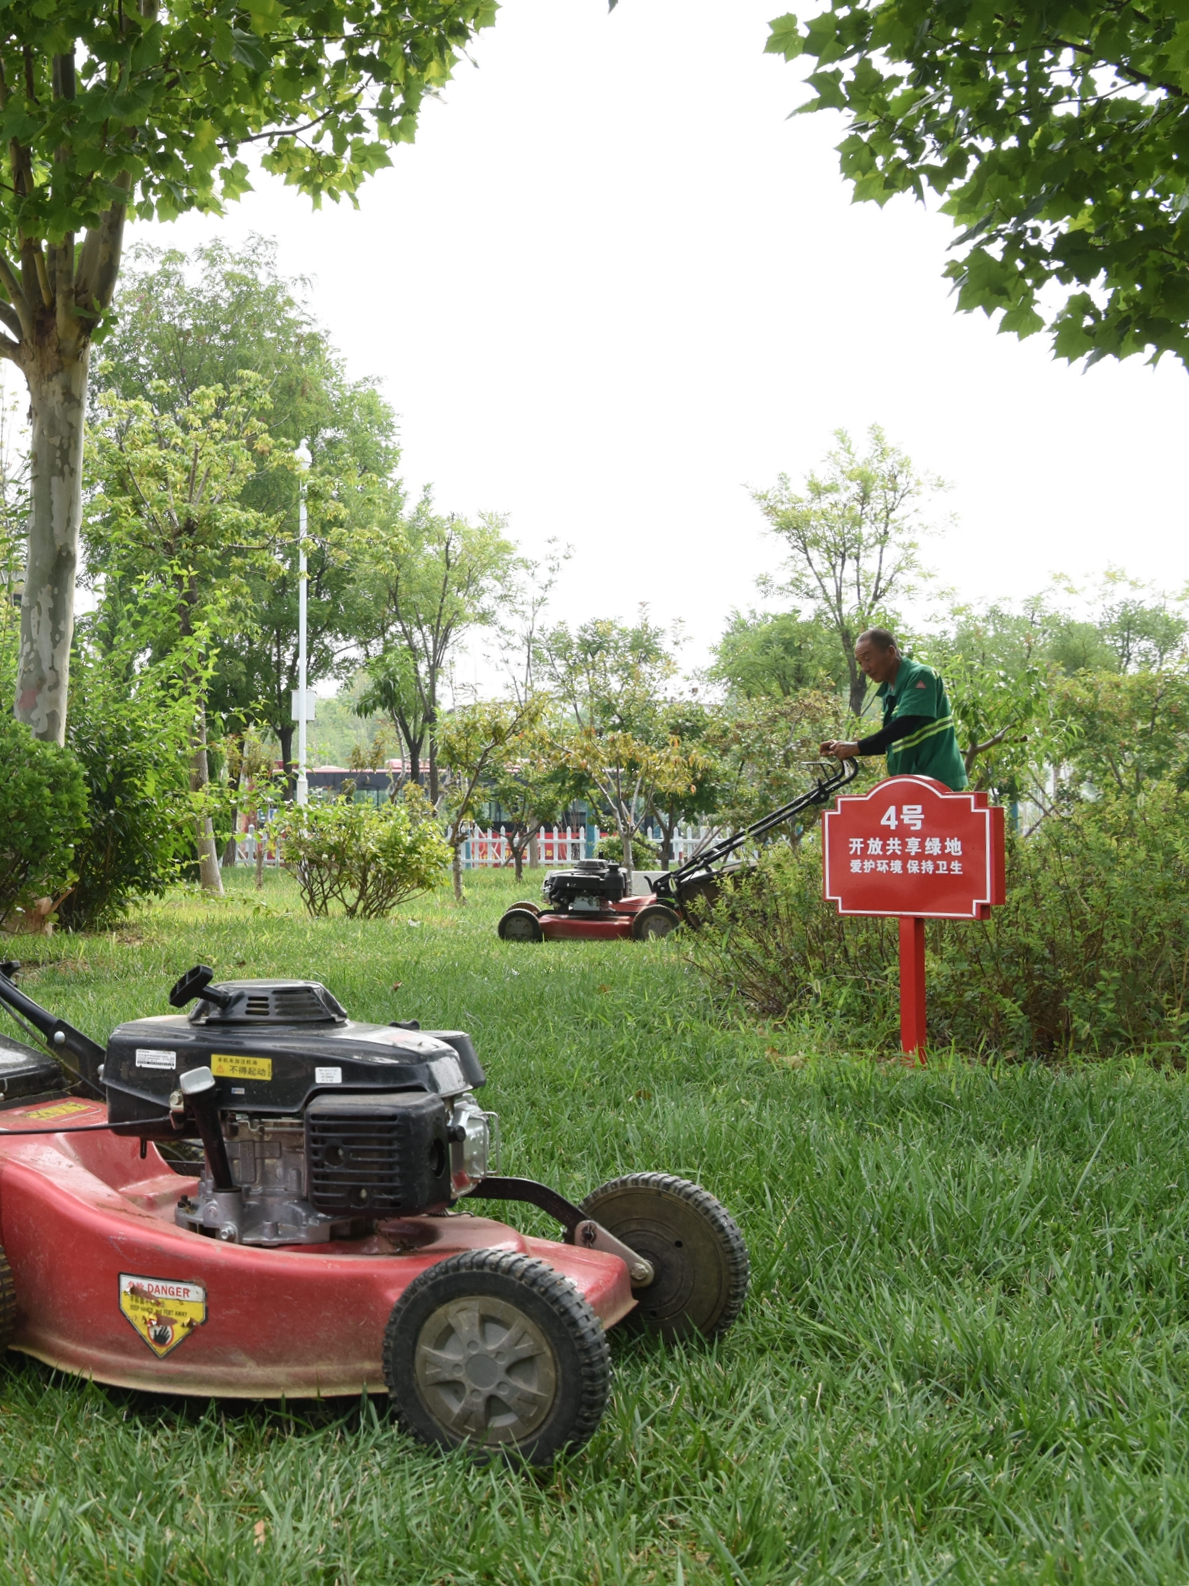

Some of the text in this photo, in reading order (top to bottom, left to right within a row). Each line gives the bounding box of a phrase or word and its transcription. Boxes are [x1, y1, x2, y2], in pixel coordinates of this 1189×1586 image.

[880, 804, 925, 830] 4号
[848, 837, 963, 856] 开放共享绿地
[850, 859, 963, 875] 爱护环境 保持卫生
[229, 1065, 267, 1077] 不得起动
[147, 1283, 190, 1298] DANGER
